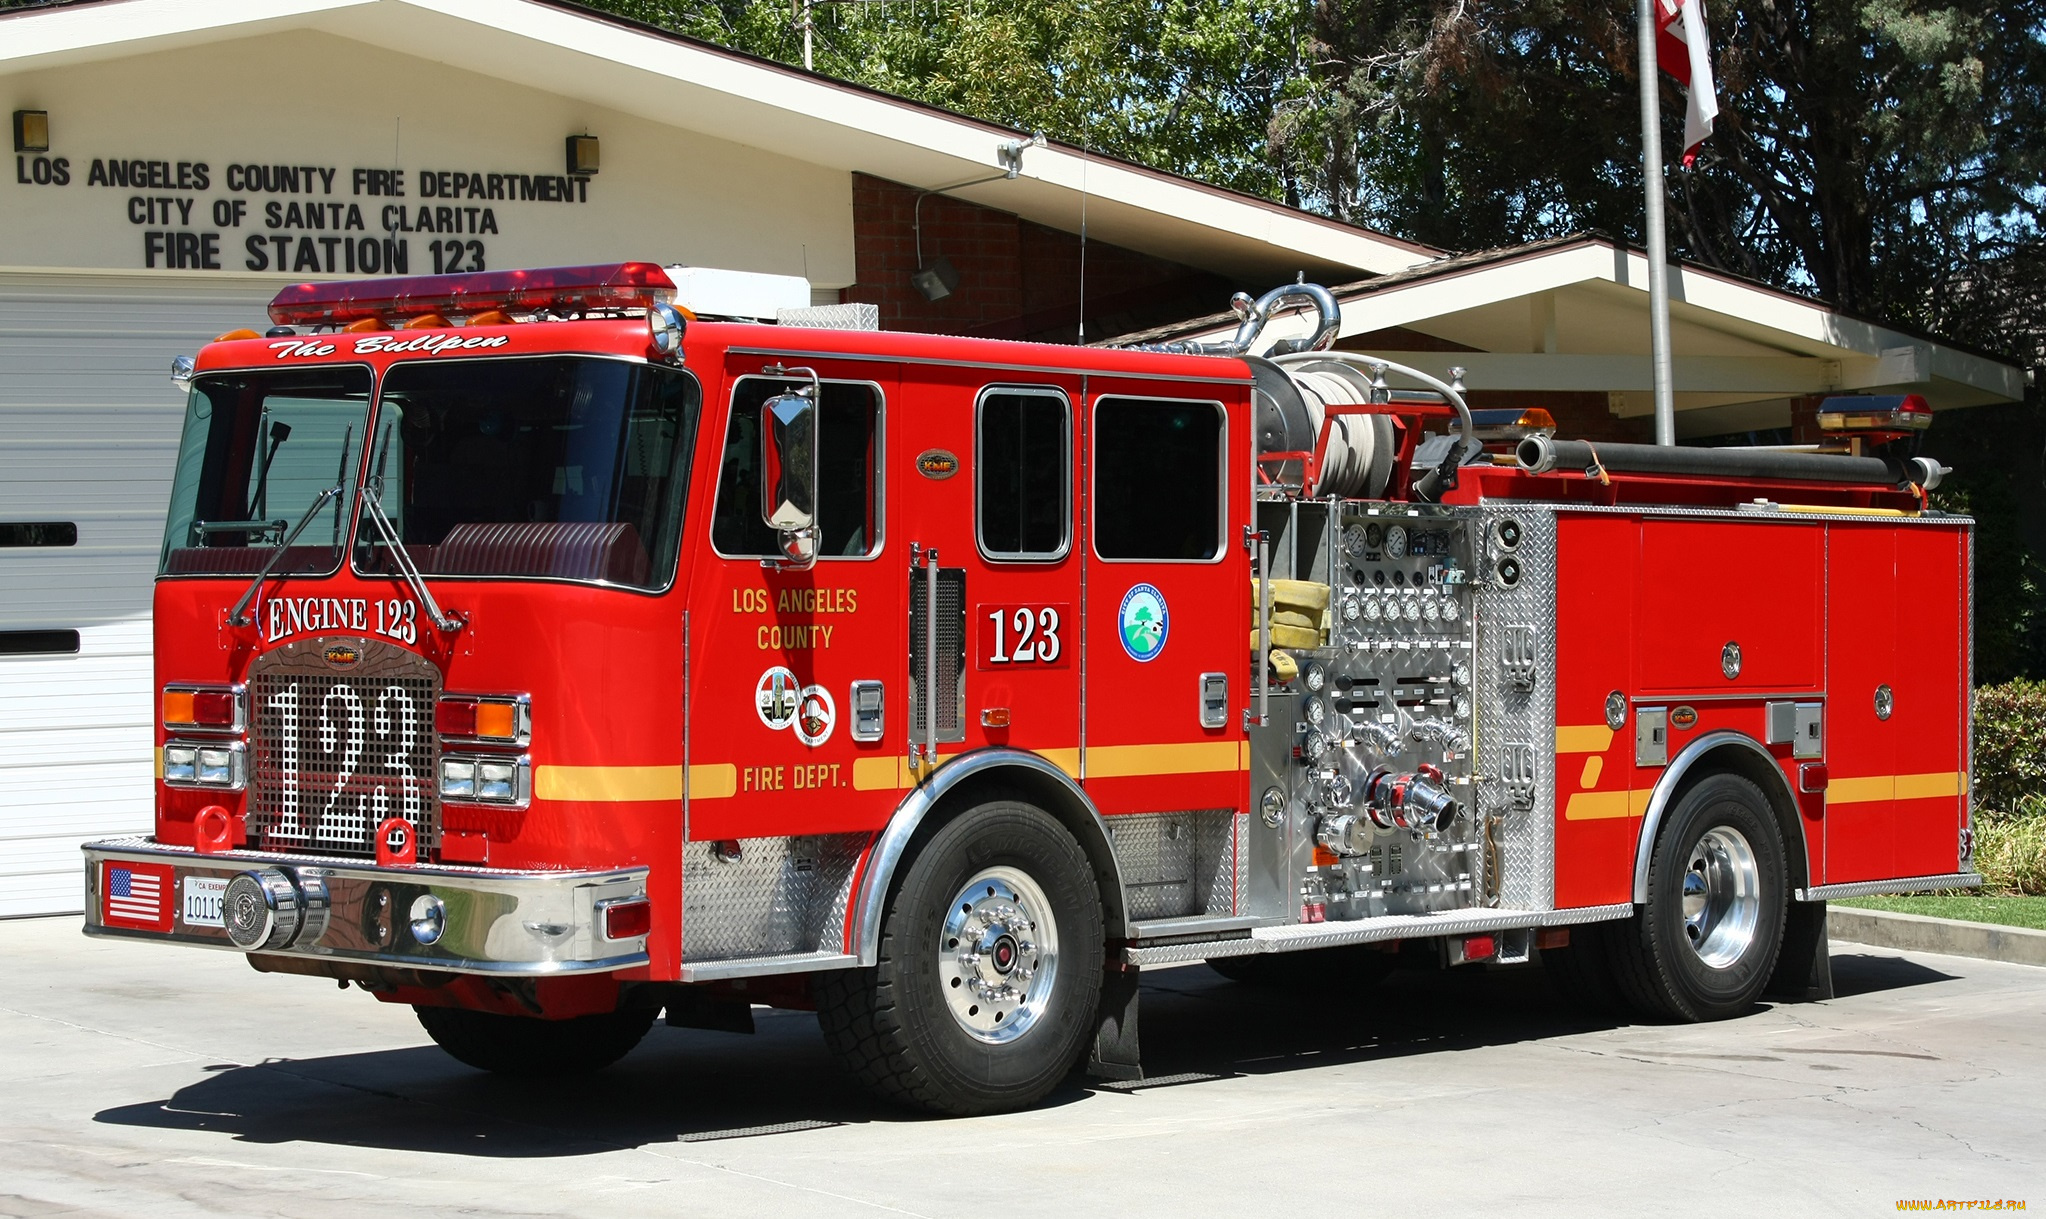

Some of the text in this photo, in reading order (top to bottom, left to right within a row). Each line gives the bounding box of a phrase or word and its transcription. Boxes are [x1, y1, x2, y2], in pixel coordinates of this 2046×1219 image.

[17, 156, 591, 203] LOS ANGELES COUNTY FIRE DEPARTMENT
[128, 196, 499, 235] CITY OF SANTA CLARITA
[145, 231, 486, 275] FIRE STATION 123
[268, 333, 509, 360] The Bullpen
[733, 588, 857, 613] LOS ANGELES
[267, 597, 418, 645] ENGINE 123
[757, 625, 834, 650] COUNTY
[989, 607, 1061, 662] 123
[268, 682, 420, 846] 123
[744, 763, 847, 792] FIRE DEPT.
[187, 895, 224, 920] 10119
